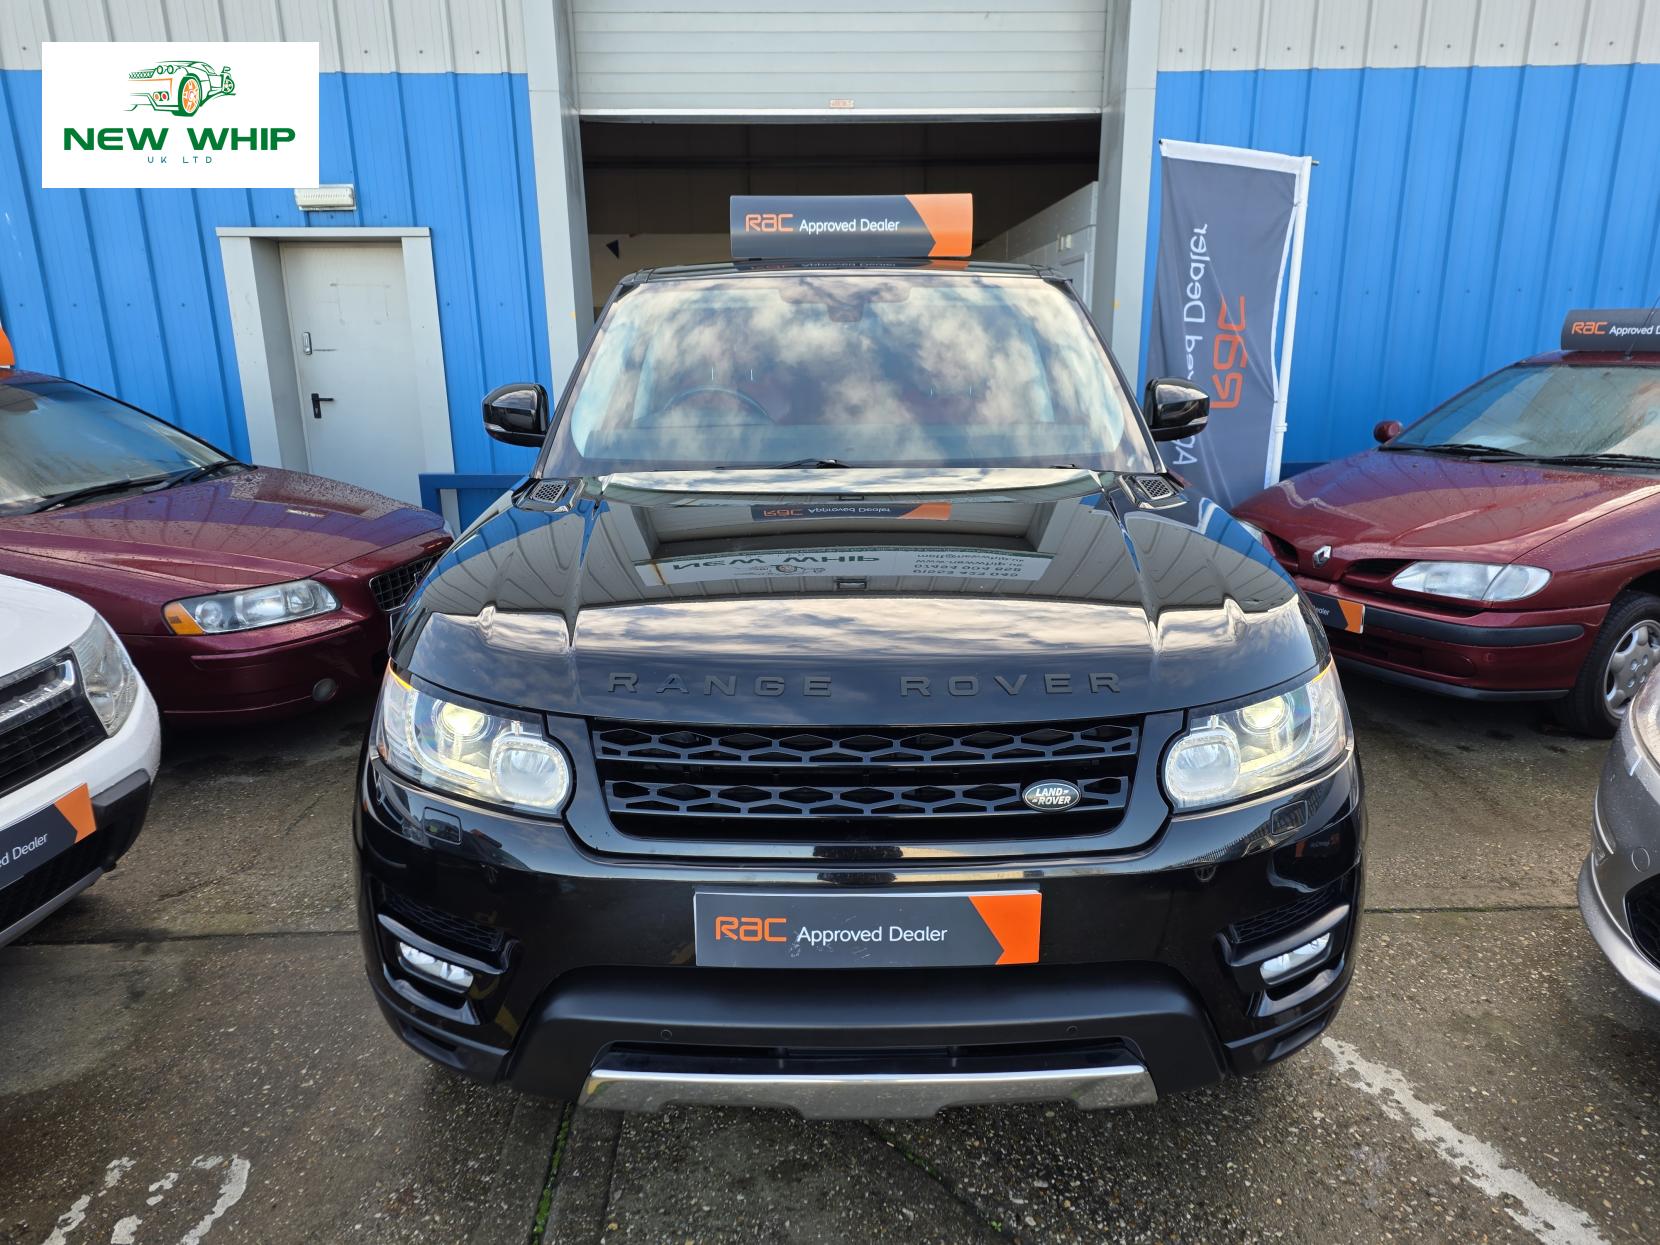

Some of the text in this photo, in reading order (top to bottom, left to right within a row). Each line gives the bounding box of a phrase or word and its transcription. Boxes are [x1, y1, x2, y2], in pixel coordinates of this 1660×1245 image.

[745, 213, 900, 236] RAC Approved Dealer
[1571, 321, 1608, 335] RAC
[1609, 324, 1654, 337] Approved
[607, 672, 1122, 698] RANGE ROVER
[1035, 787, 1063, 797] LAND
[1037, 796, 1071, 805] ROVER
[12, 833, 48, 860] Dealer
[714, 915, 948, 946] RAC Approved Dealer
